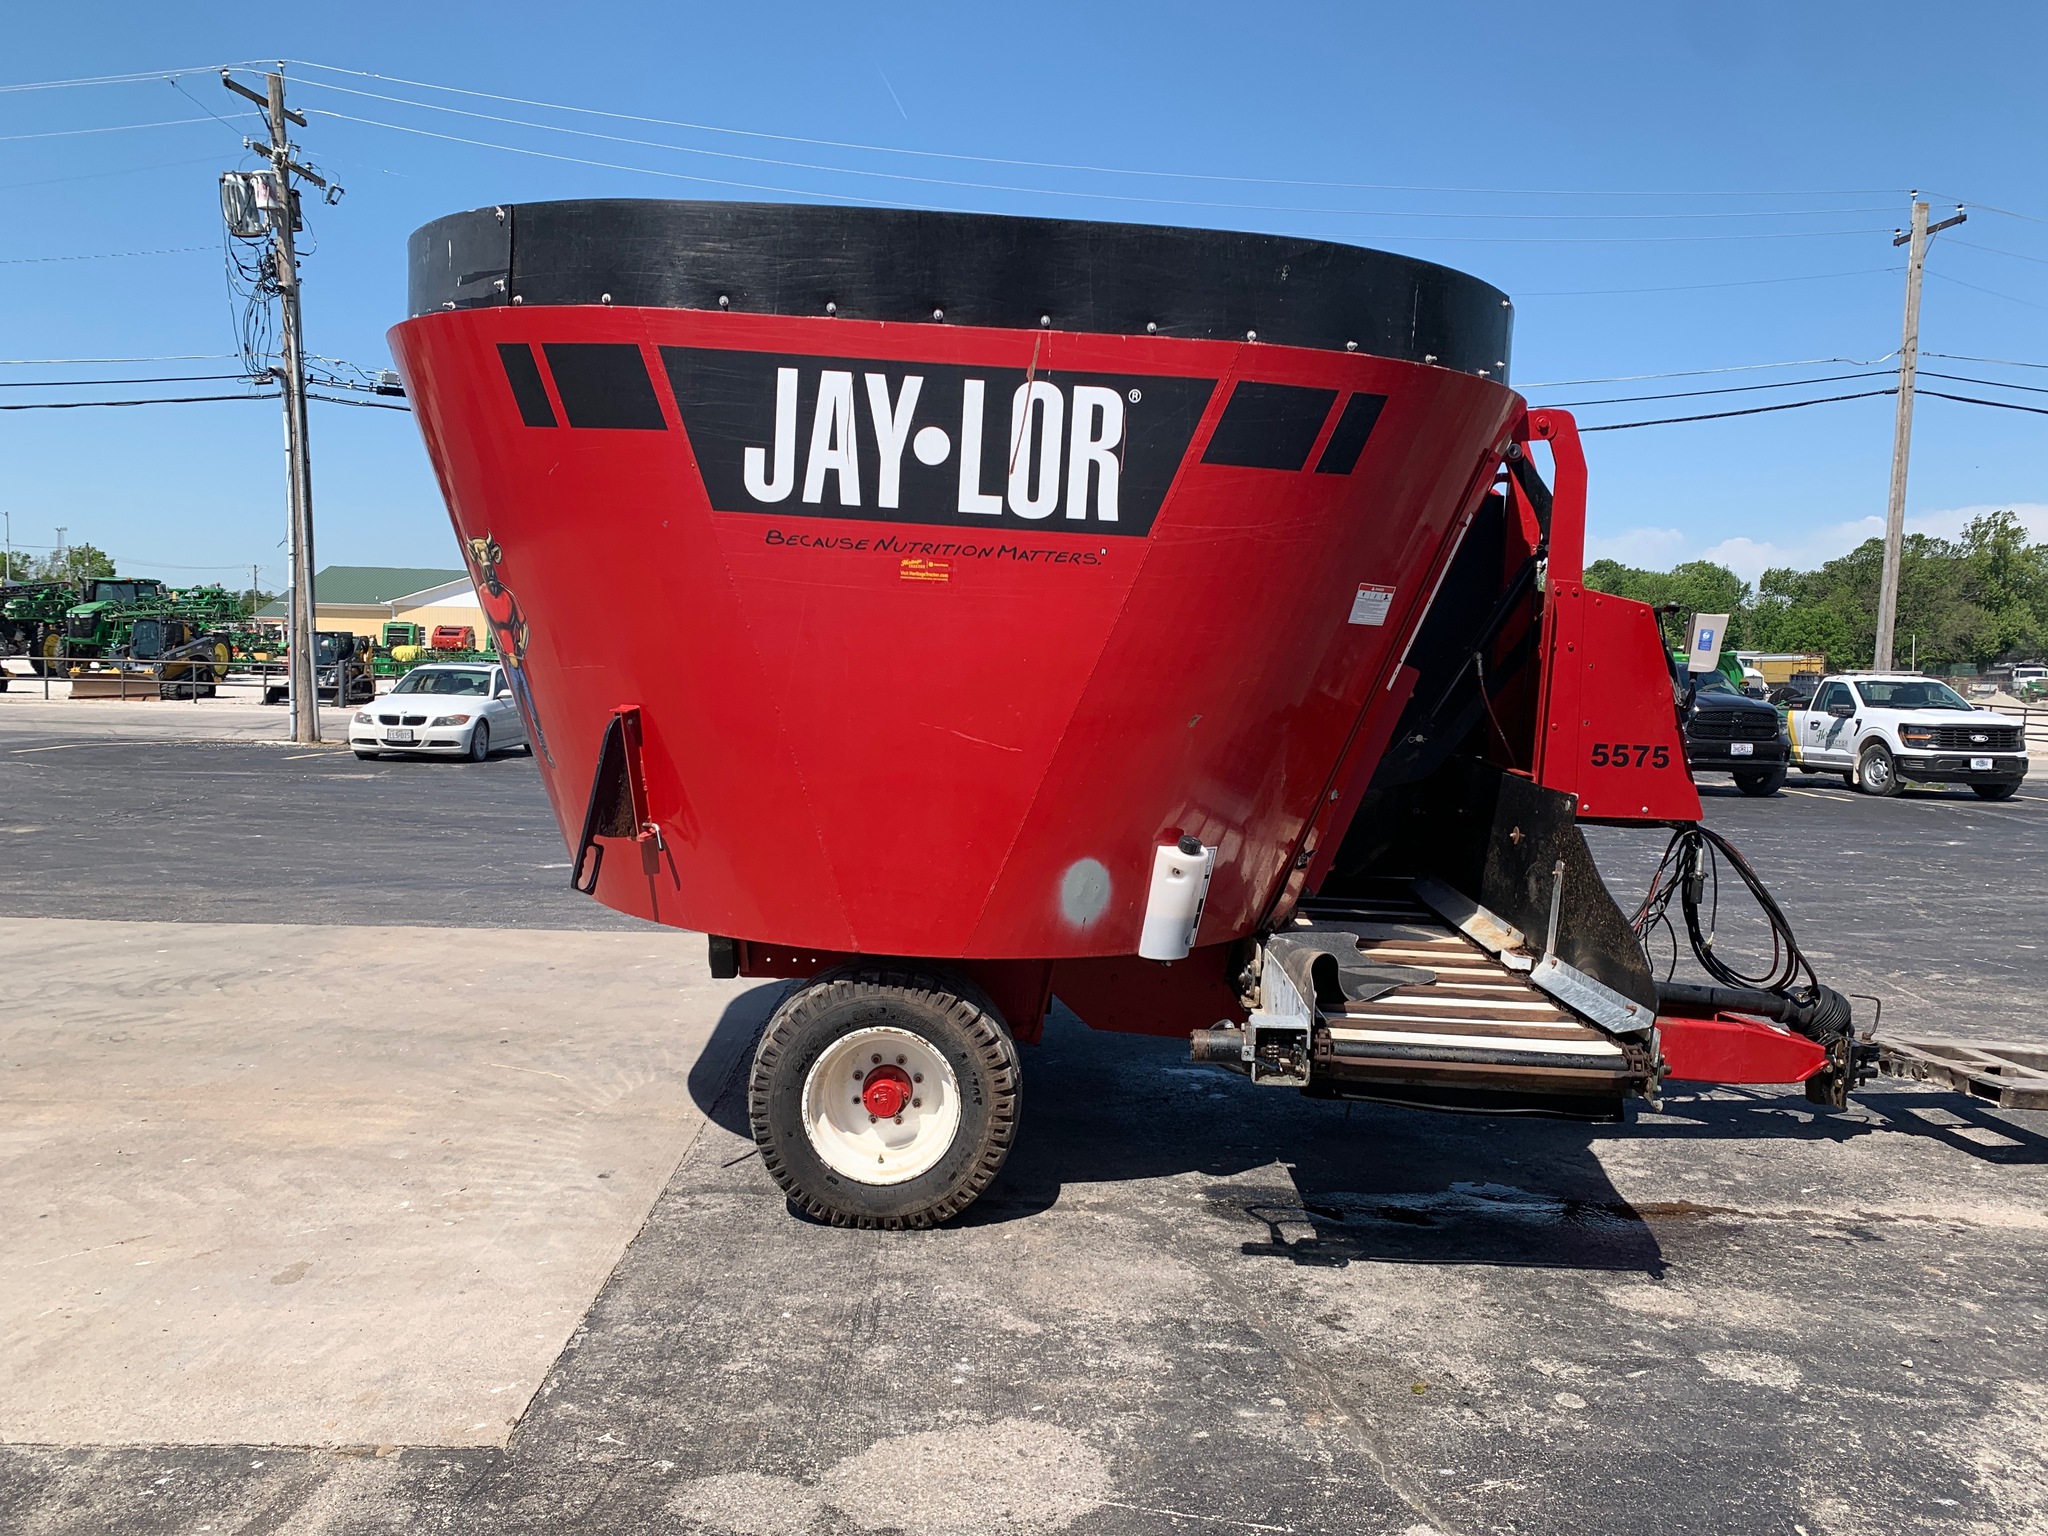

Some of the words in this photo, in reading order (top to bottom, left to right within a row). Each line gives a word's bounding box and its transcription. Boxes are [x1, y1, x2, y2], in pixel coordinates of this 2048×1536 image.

[765, 529, 870, 551] BECAUSE
[873, 536, 995, 559] NUTRITION
[996, 544, 1102, 566] MATTERS.
[1590, 743, 1670, 769] 5575
